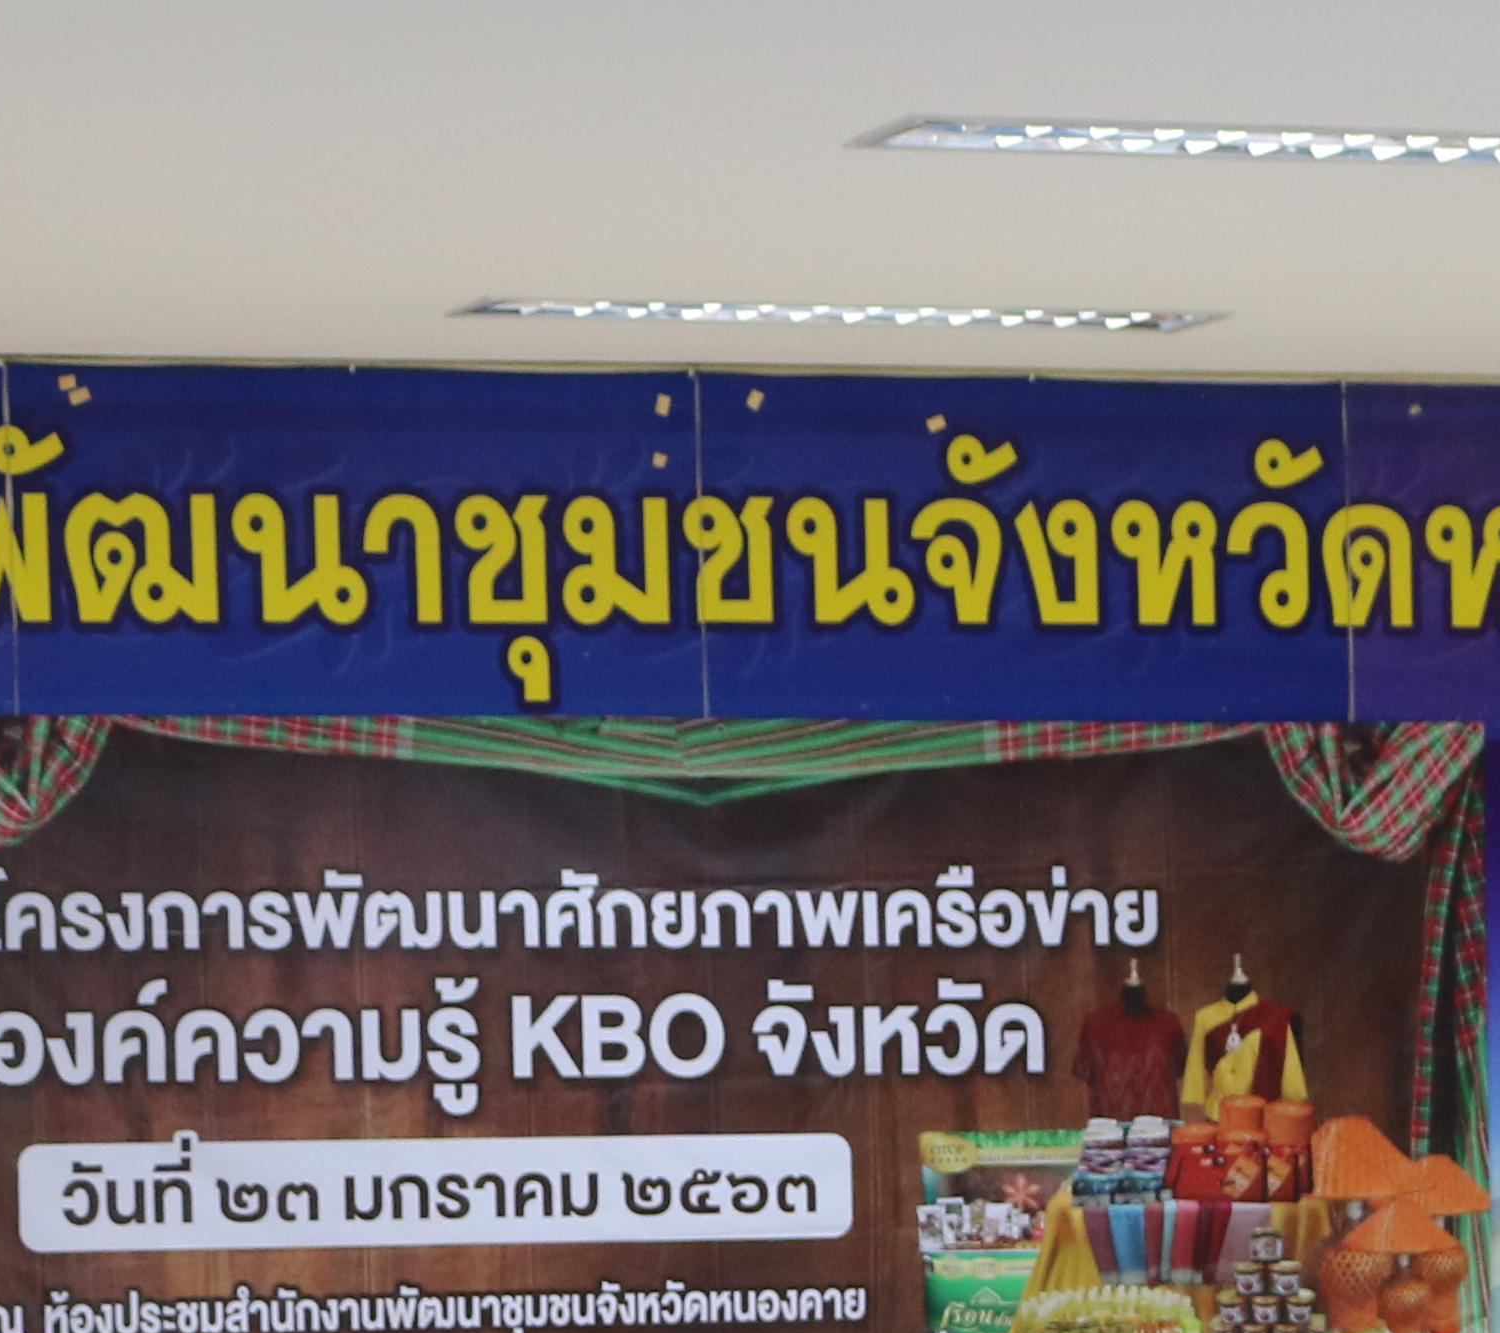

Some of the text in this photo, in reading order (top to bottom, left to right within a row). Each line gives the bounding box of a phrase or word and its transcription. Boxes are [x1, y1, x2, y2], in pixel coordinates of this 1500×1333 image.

[511, 992, 726, 1078] KBO
[751, 977, 1045, 1077] จังหวัด
[61, 1137, 818, 1226] วันที่ ๒๓ มกราคม ๒๕๖๓
